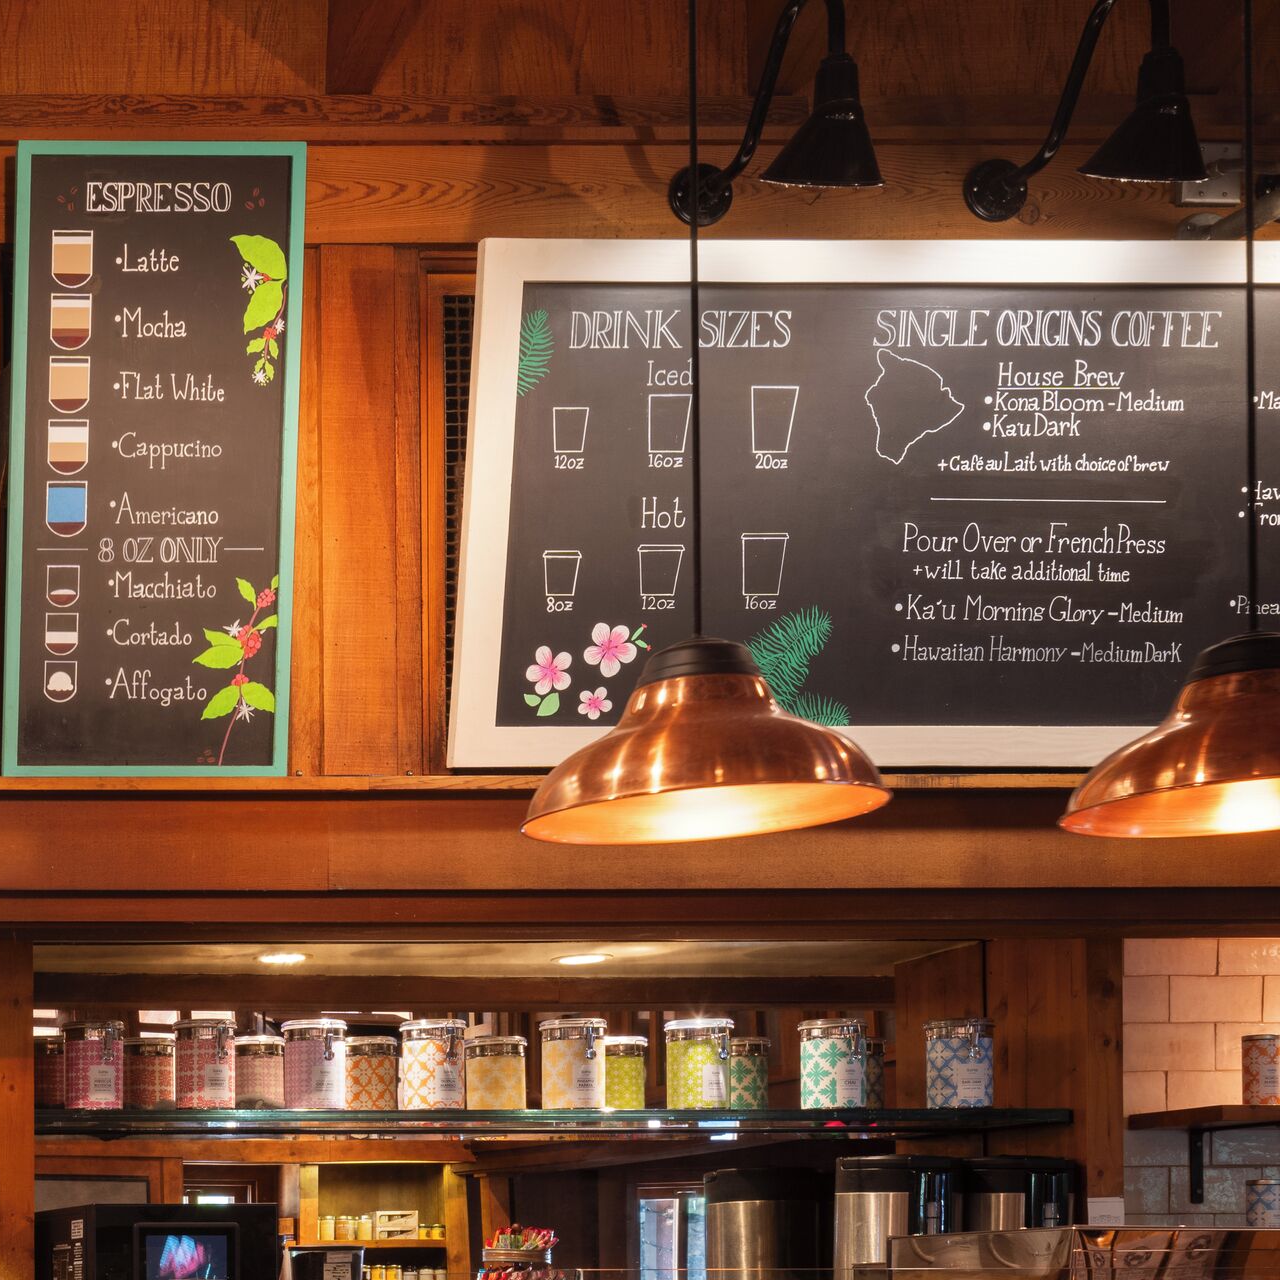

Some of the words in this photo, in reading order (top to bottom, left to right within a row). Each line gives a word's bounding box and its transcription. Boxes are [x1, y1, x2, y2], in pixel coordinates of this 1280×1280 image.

[86, 182, 232, 212] ESPRESSO
[122, 244, 180, 272] Latte
[122, 307, 187, 338] Mocha
[568, 310, 682, 349] DRINK
[698, 310, 793, 348] SIZES
[873, 309, 990, 348] SINGLE
[996, 310, 1103, 347] ORIGINS
[1111, 310, 1223, 348] COFFEE
[119, 371, 164, 400] Flat
[170, 373, 225, 402] White
[647, 358, 693, 387] Iced
[997, 362, 1064, 388] House
[1073, 359, 1125, 388] Brew
[118, 432, 222, 470] Cappucino
[115, 492, 219, 525] Americano
[641, 496, 686, 529] Hot
[98, 537, 115, 563] 8
[122, 537, 154, 563] OZ
[159, 537, 223, 563] ONLY
[902, 522, 958, 554] Pour
[962, 522, 1018, 554] Over
[1020, 535, 1042, 553] or
[1045, 522, 1115, 555] French
[1116, 523, 1166, 556] Press
[114, 571, 217, 599] Macchiato
[112, 618, 192, 646] Cortado
[109, 667, 208, 707] Affogato
